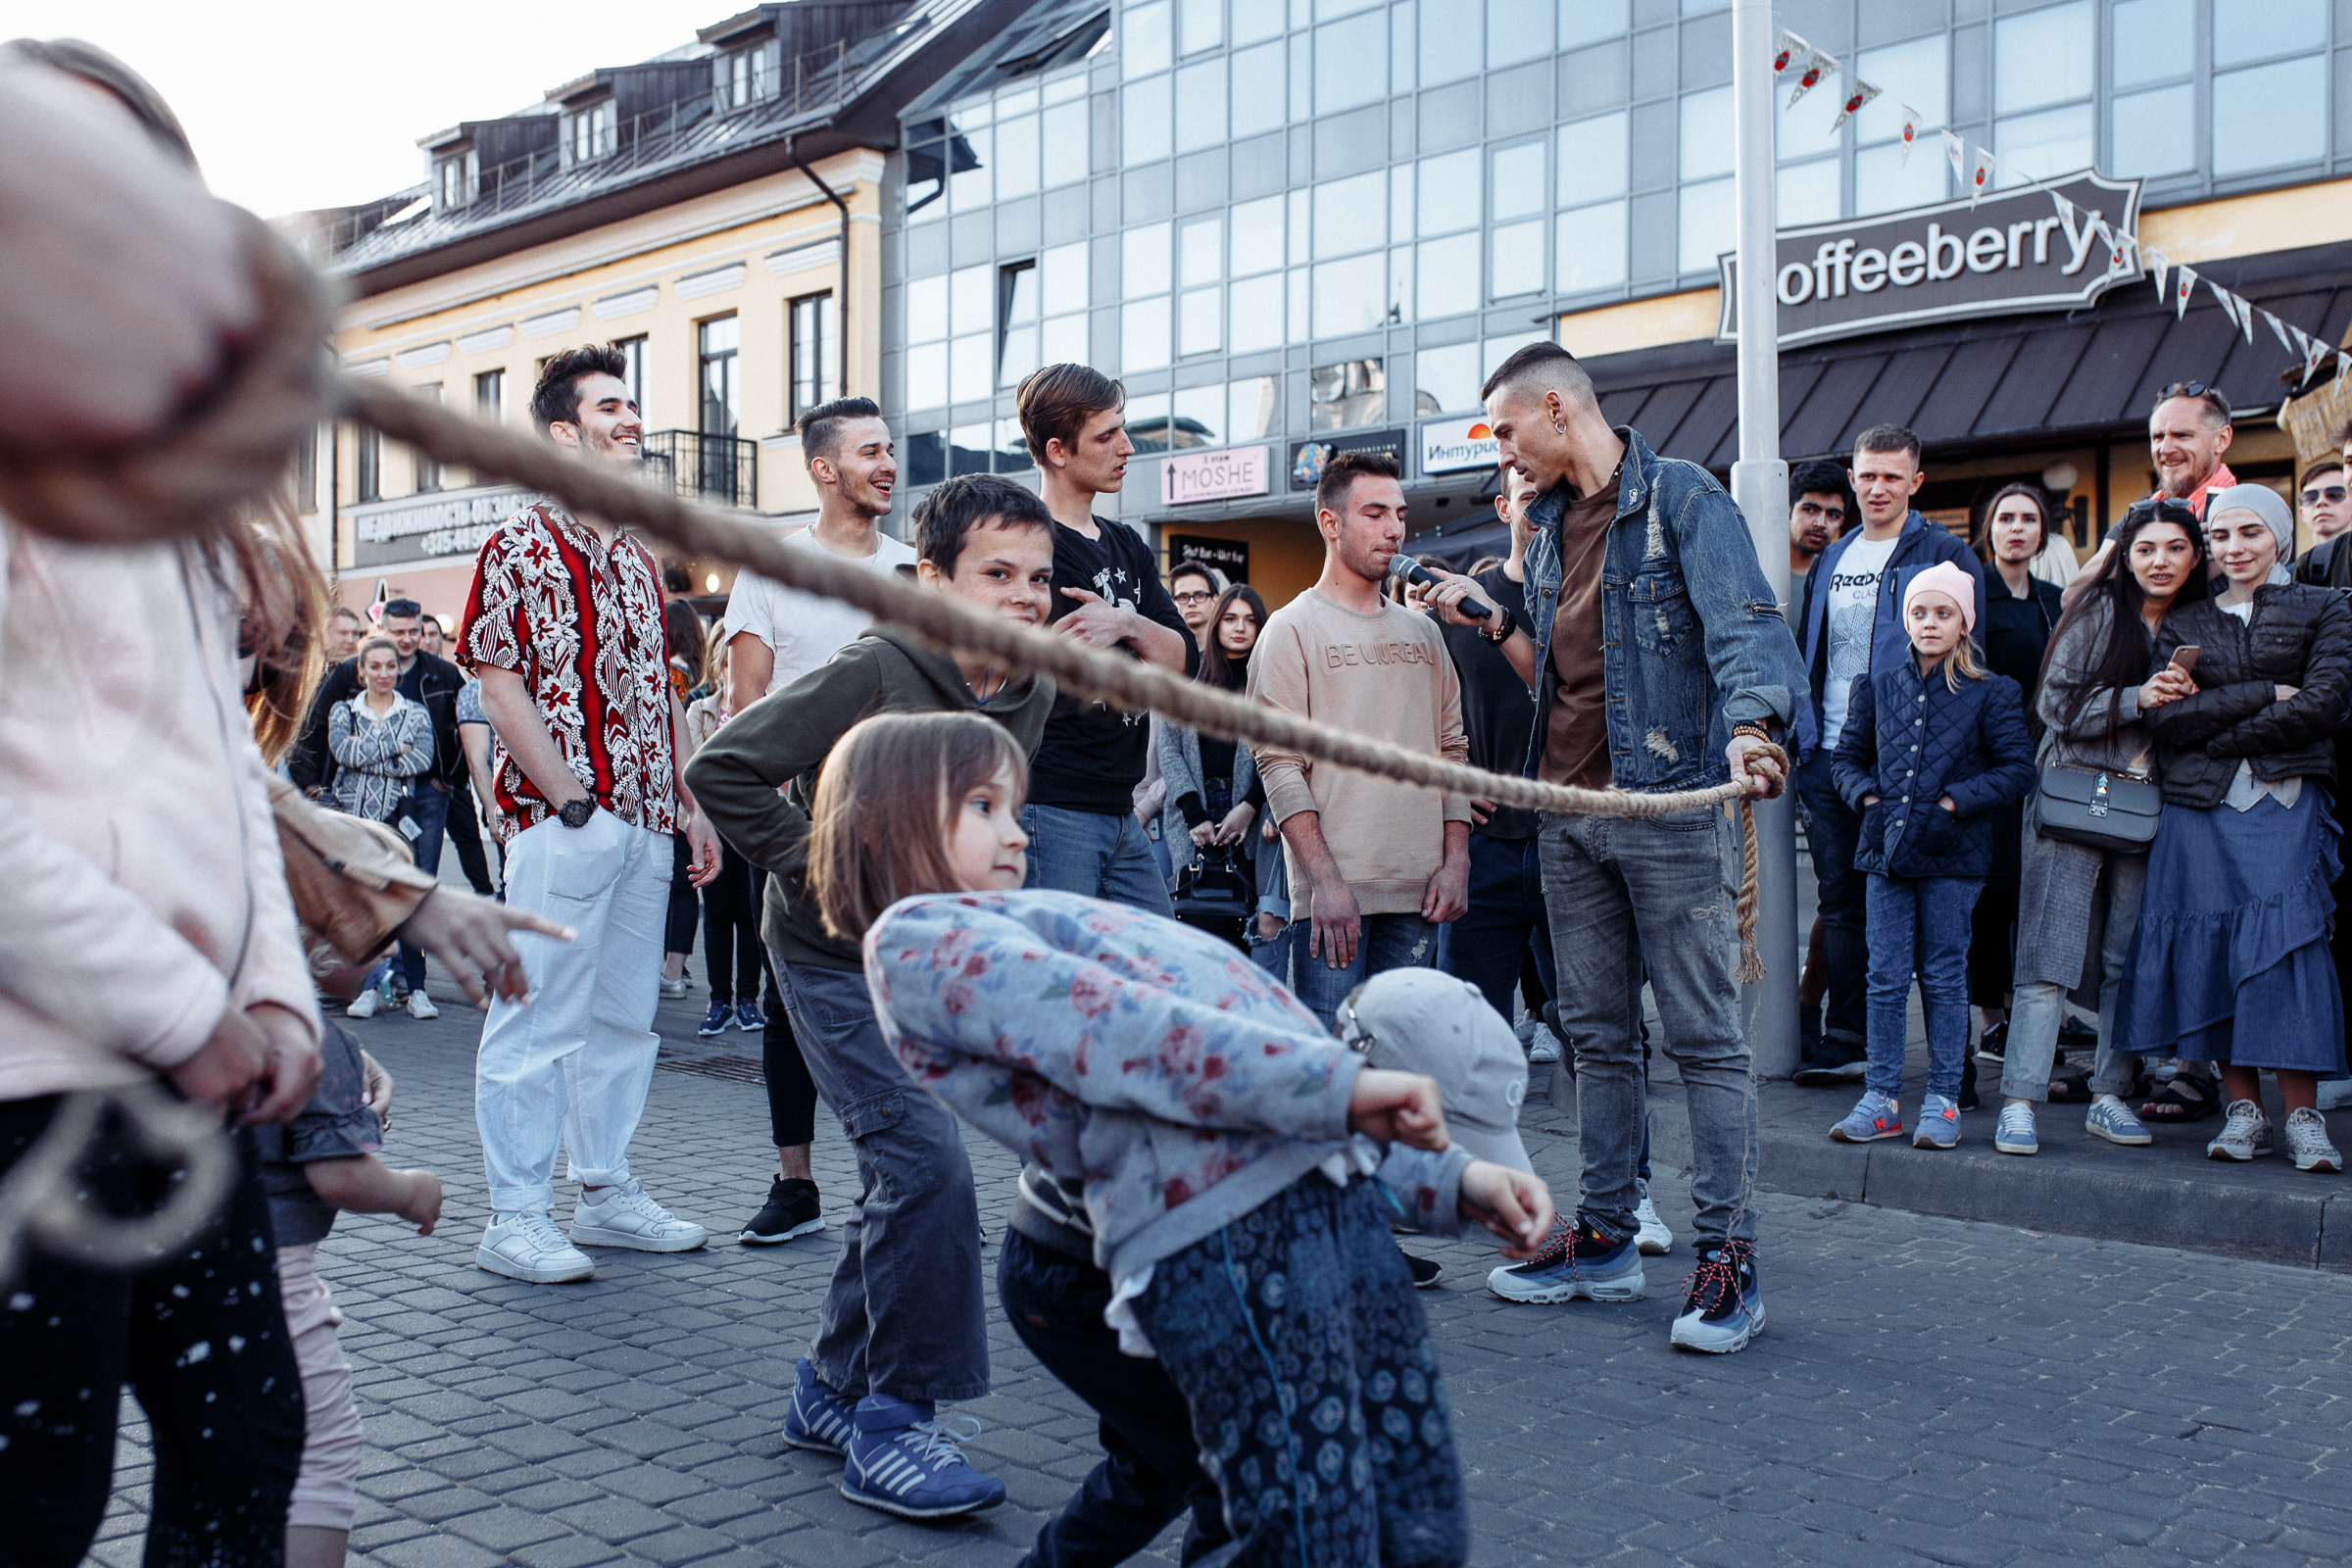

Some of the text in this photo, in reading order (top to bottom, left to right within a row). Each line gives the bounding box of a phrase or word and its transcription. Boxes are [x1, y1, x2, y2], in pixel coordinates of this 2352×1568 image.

[1776, 210, 2102, 306] offeeberry
[1182, 462, 1253, 491] MOSHE
[1325, 643, 1358, 668] BE
